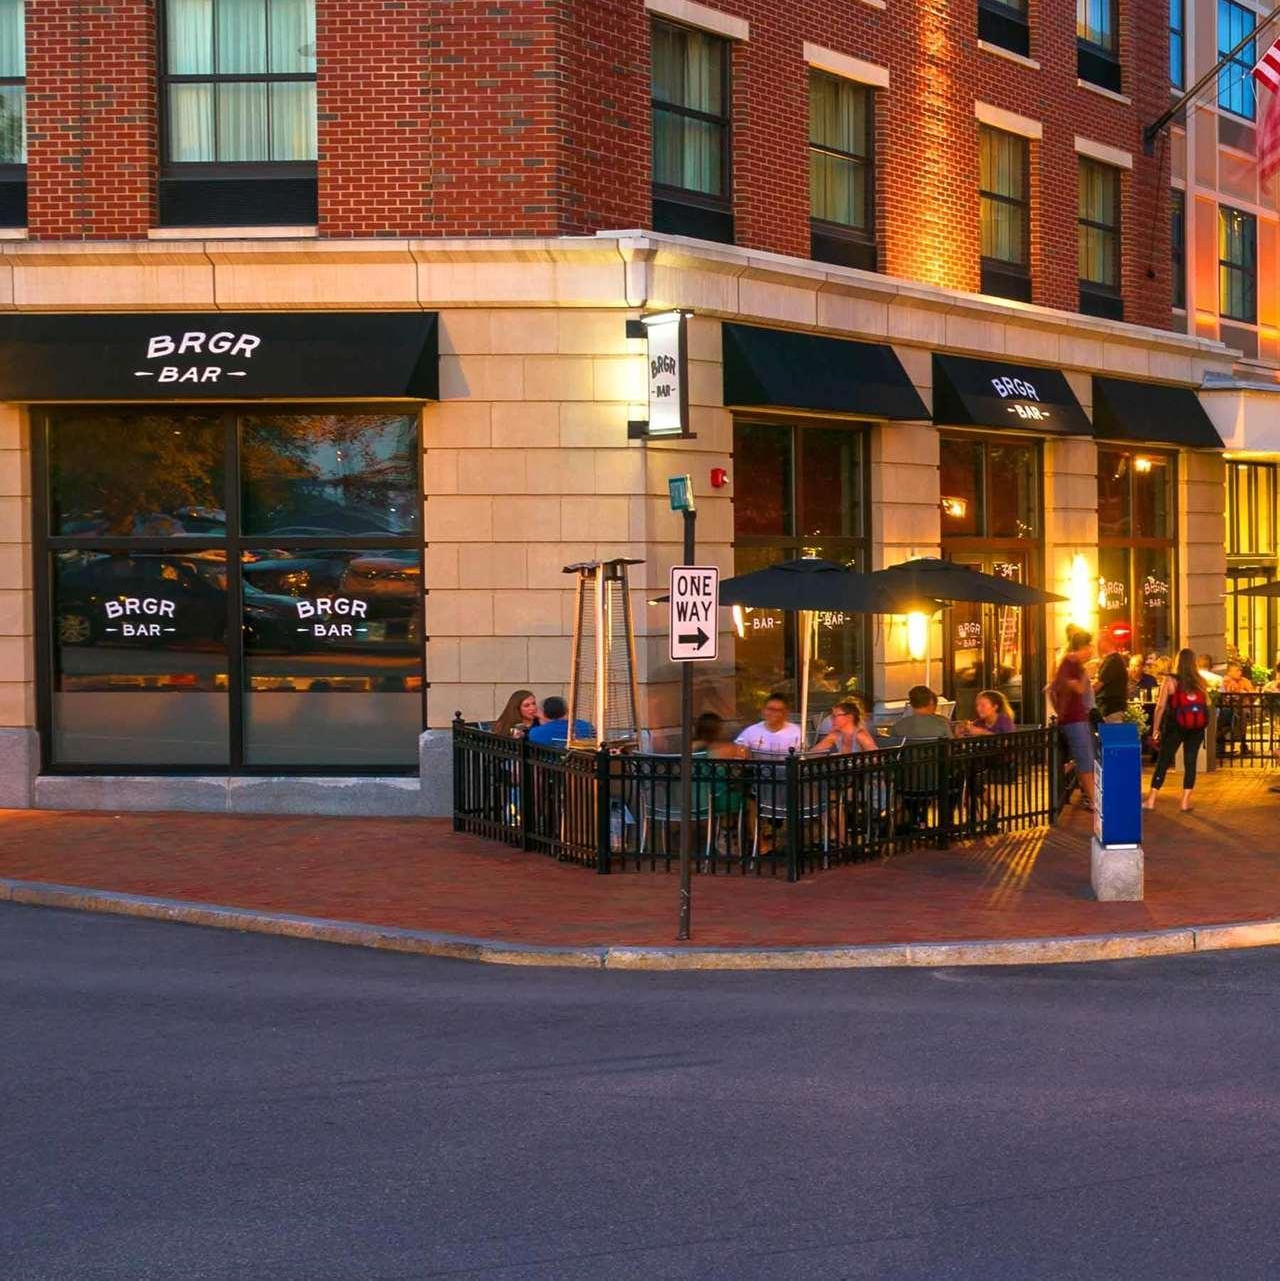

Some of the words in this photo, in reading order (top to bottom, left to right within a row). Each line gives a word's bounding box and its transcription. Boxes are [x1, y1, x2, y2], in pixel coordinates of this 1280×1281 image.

[147, 332, 261, 359] BRGR
[158, 367, 222, 383] BAR
[651, 354, 676, 379] BRGR
[656, 384, 671, 398] BAR
[991, 376, 1040, 401] BRGR
[1014, 404, 1044, 420] BAR
[678, 576, 712, 596] ONE
[105, 598, 175, 618] BRGR
[297, 598, 368, 618] BRGR
[676, 601, 713, 622] WAY
[753, 618, 774, 629] BAR
[825, 614, 844, 626] BAR
[123, 624, 161, 636] BAR
[314, 624, 352, 636] BAR
